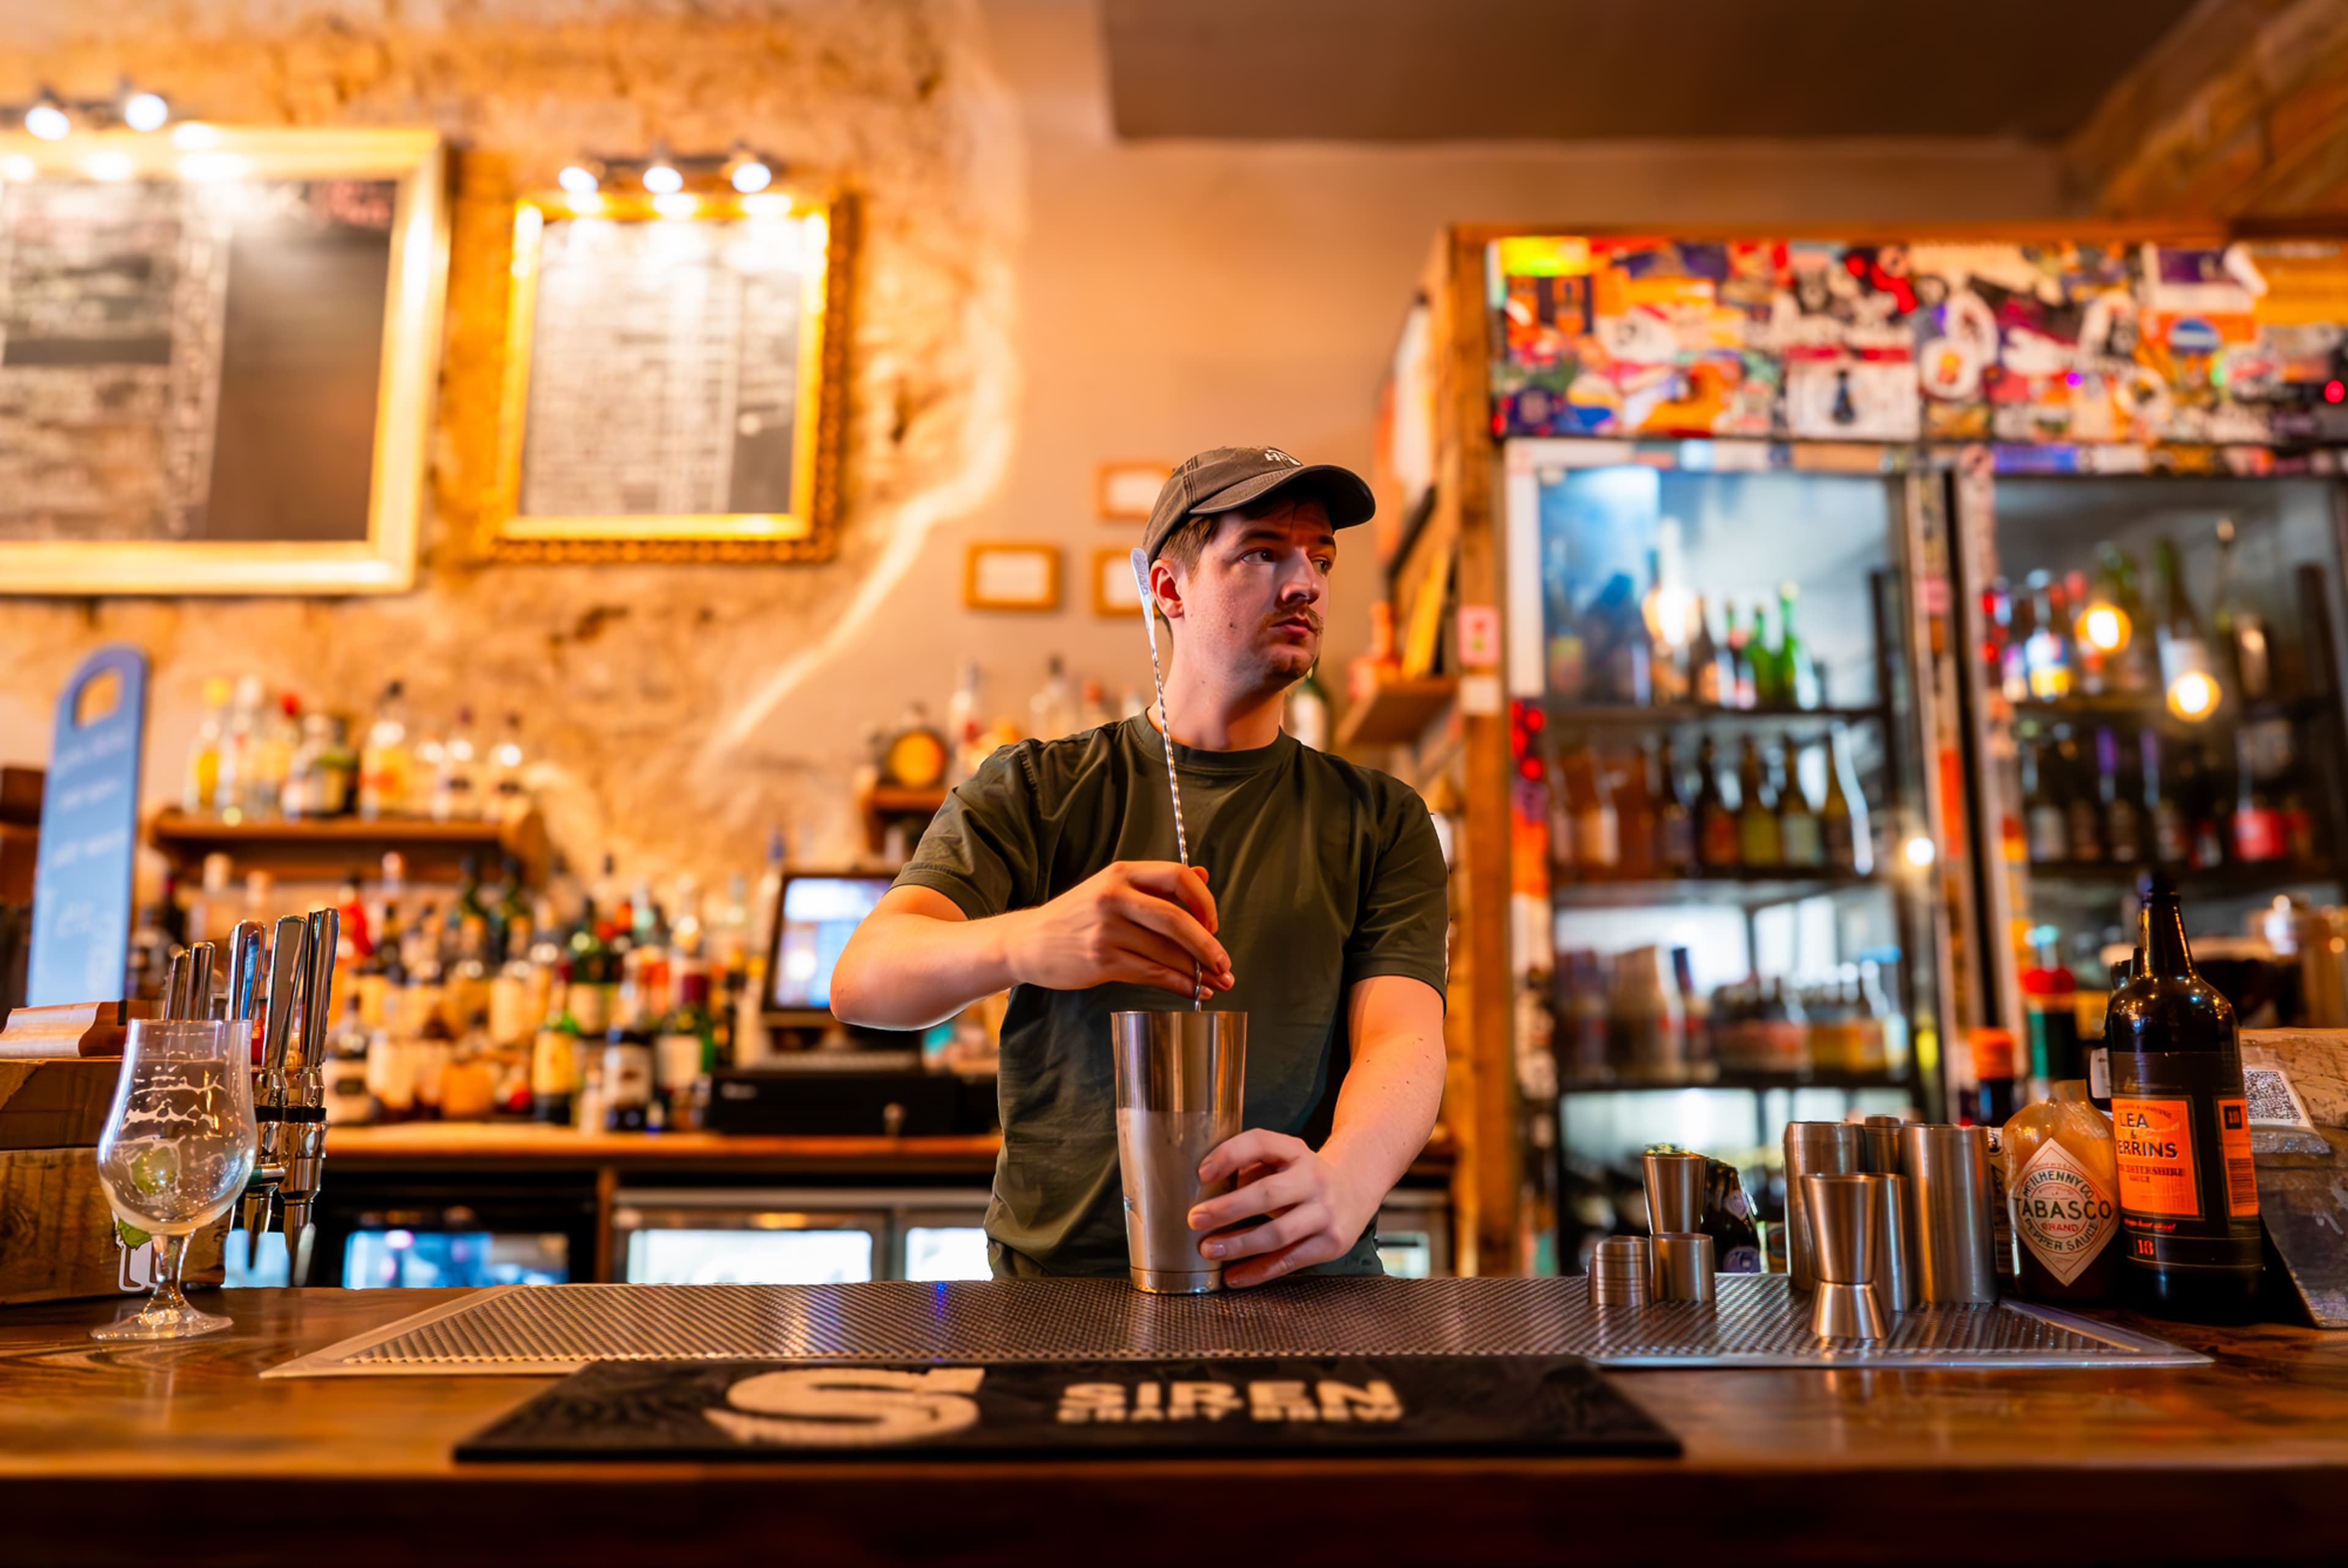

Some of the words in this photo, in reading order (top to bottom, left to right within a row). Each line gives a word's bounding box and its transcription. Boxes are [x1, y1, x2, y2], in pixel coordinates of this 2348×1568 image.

[2119, 1112, 2149, 1128] LEA
[2117, 1139, 2178, 1158] ERRINS
[2012, 1196, 2111, 1220] TABASCO
[2025, 1218, 2063, 1251] PEPPER
[2066, 1222, 2099, 1251] SAUCE
[2041, 1223, 2079, 1233] BRAND
[2137, 1239, 2154, 1256] 18
[1060, 1380, 1401, 1407] SIREN
